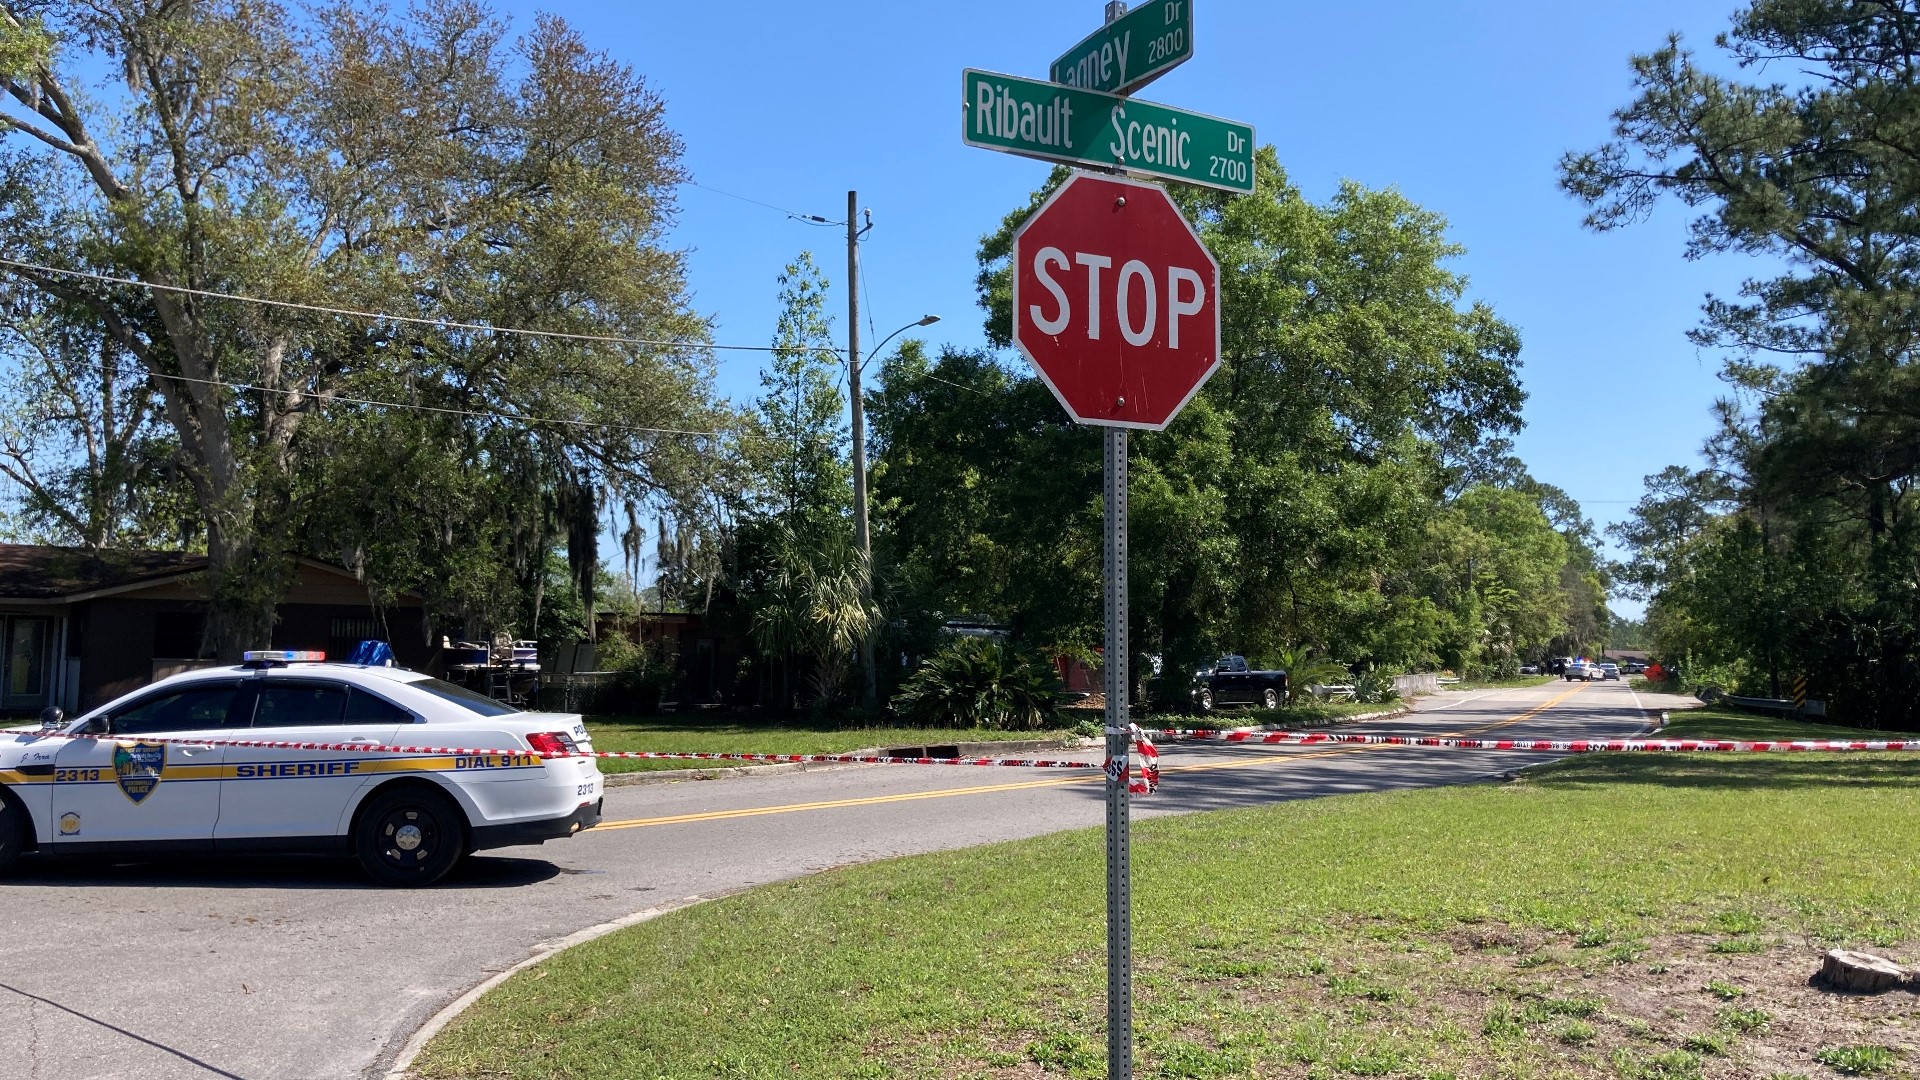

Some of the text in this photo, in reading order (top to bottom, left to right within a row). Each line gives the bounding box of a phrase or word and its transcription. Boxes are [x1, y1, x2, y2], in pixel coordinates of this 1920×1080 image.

[1164, 1, 1183, 26] Dr
[1148, 27, 1183, 64] 2800
[976, 80, 1246, 170] Ribault Scenic Dr
[1209, 155, 1247, 183] 2700
[1029, 246, 1206, 350] STOP
[236, 761, 360, 778] SHERIFF
[455, 755, 532, 769] DIAL 911
[56, 768, 100, 782] 2313
[577, 783, 594, 796] 2313
